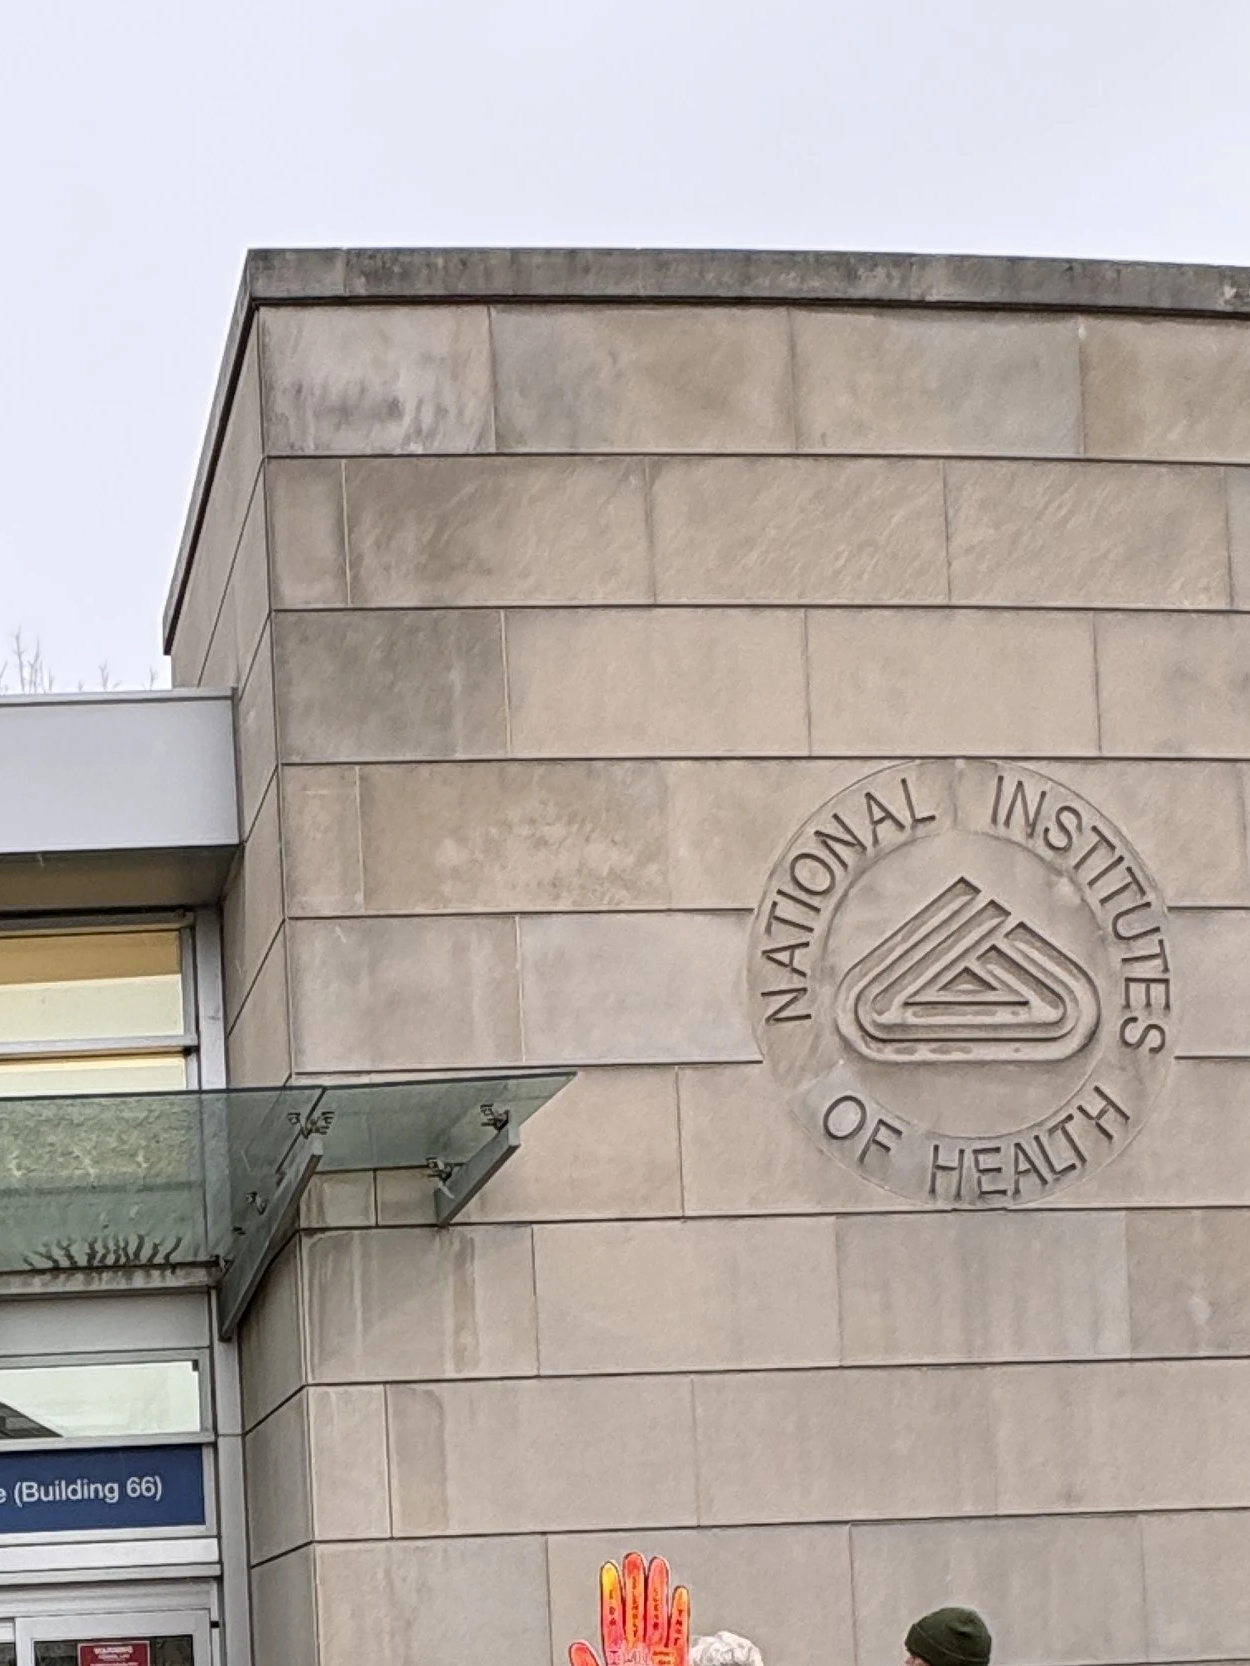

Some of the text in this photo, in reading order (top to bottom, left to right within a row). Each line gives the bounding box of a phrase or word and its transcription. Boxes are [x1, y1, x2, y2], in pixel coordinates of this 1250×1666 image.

[761, 775, 1171, 1055] NATIONAL INSTITUTES
[823, 1085, 1131, 1199] OF HEALTH
[14, 1479, 119, 1508] (Building
[126, 1476, 163, 1501] 66)
